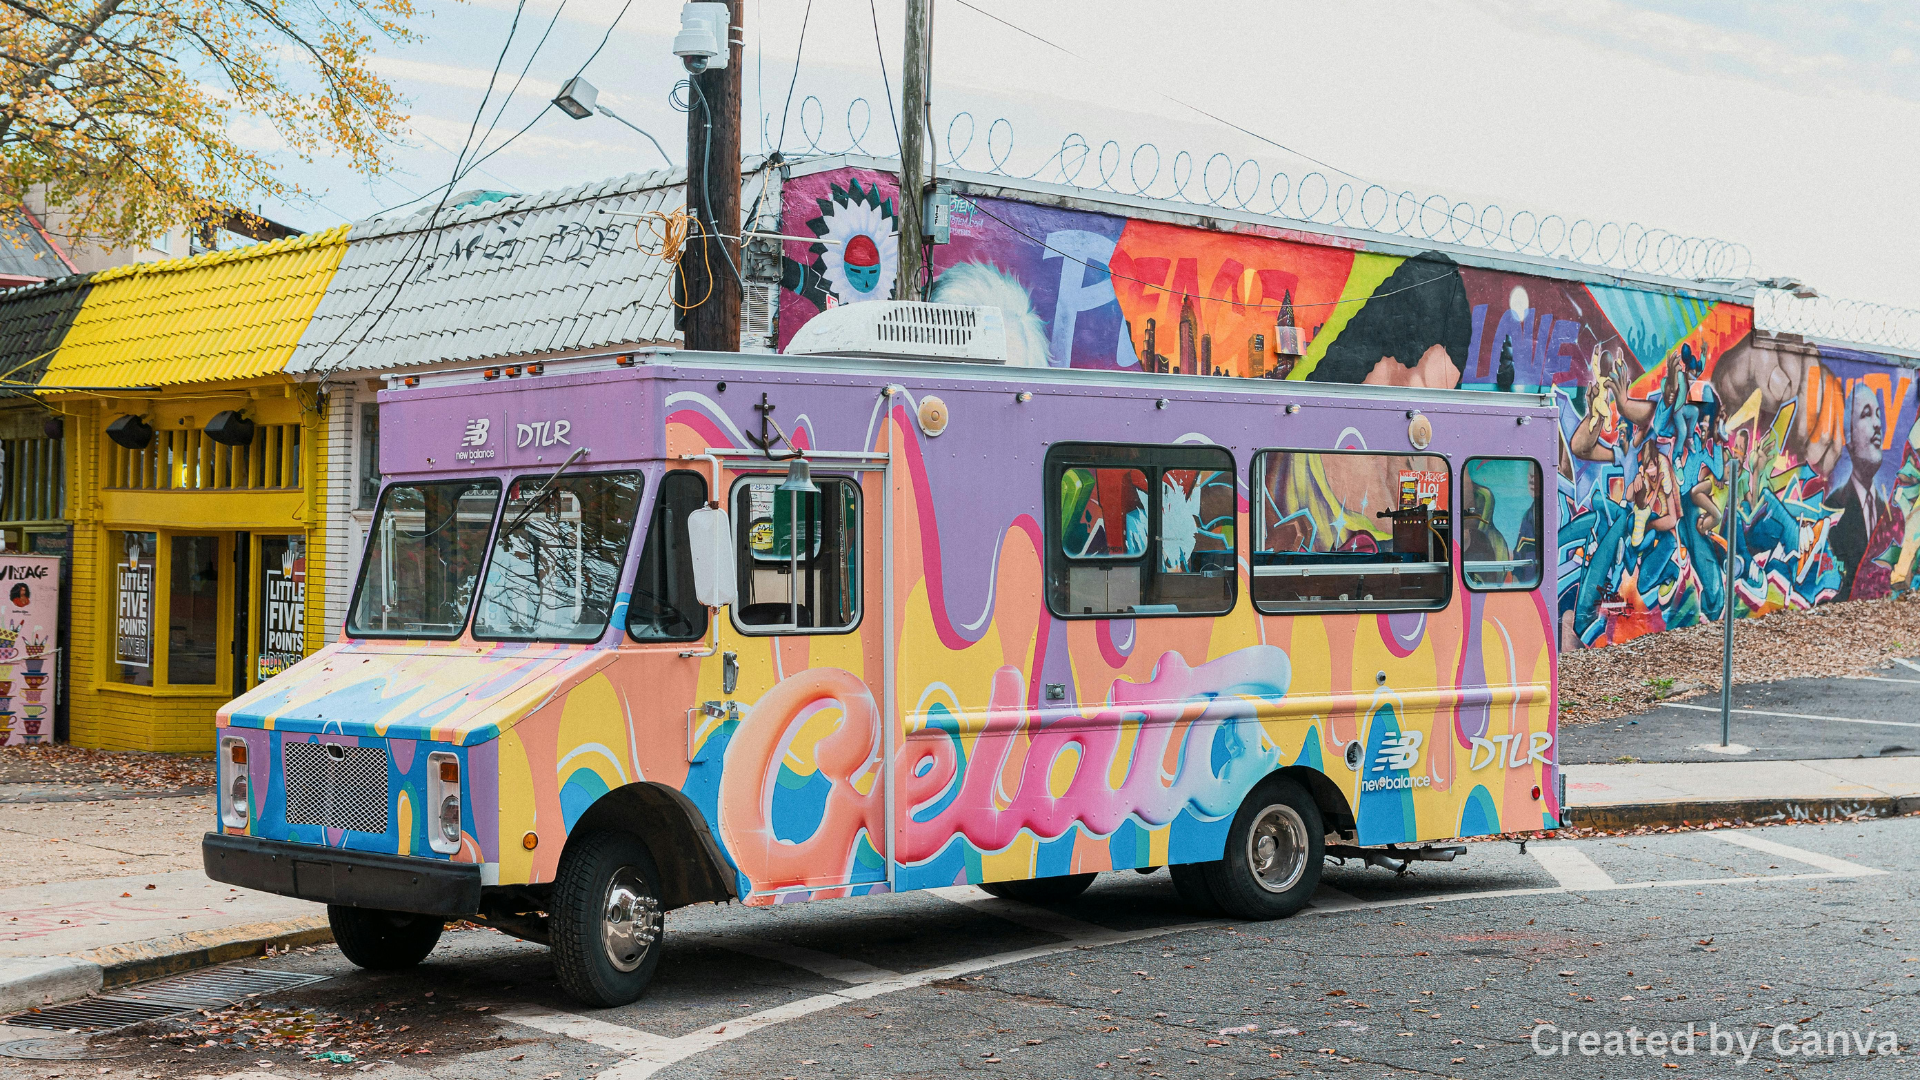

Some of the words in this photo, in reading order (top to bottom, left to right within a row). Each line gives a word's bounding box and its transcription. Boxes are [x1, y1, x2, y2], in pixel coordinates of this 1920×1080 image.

[1043, 229, 1299, 371] PEACE
[1462, 304, 1581, 399] LOVE
[1806, 366, 1911, 450] UNTY
[516, 419, 571, 448] DTLR
[469, 449, 495, 459] balance
[120, 572, 147, 591] LITTLE
[270, 580, 305, 601] LITTLE
[120, 592, 147, 618] FIVE
[269, 601, 304, 631] FIVE
[119, 618, 146, 636] POINTS
[119, 636, 146, 656] DINER
[268, 631, 303, 652] POINTS
[1470, 732, 1554, 771] DTLR
[718, 645, 1292, 905] Gelato
[1386, 775, 1431, 789] balance
